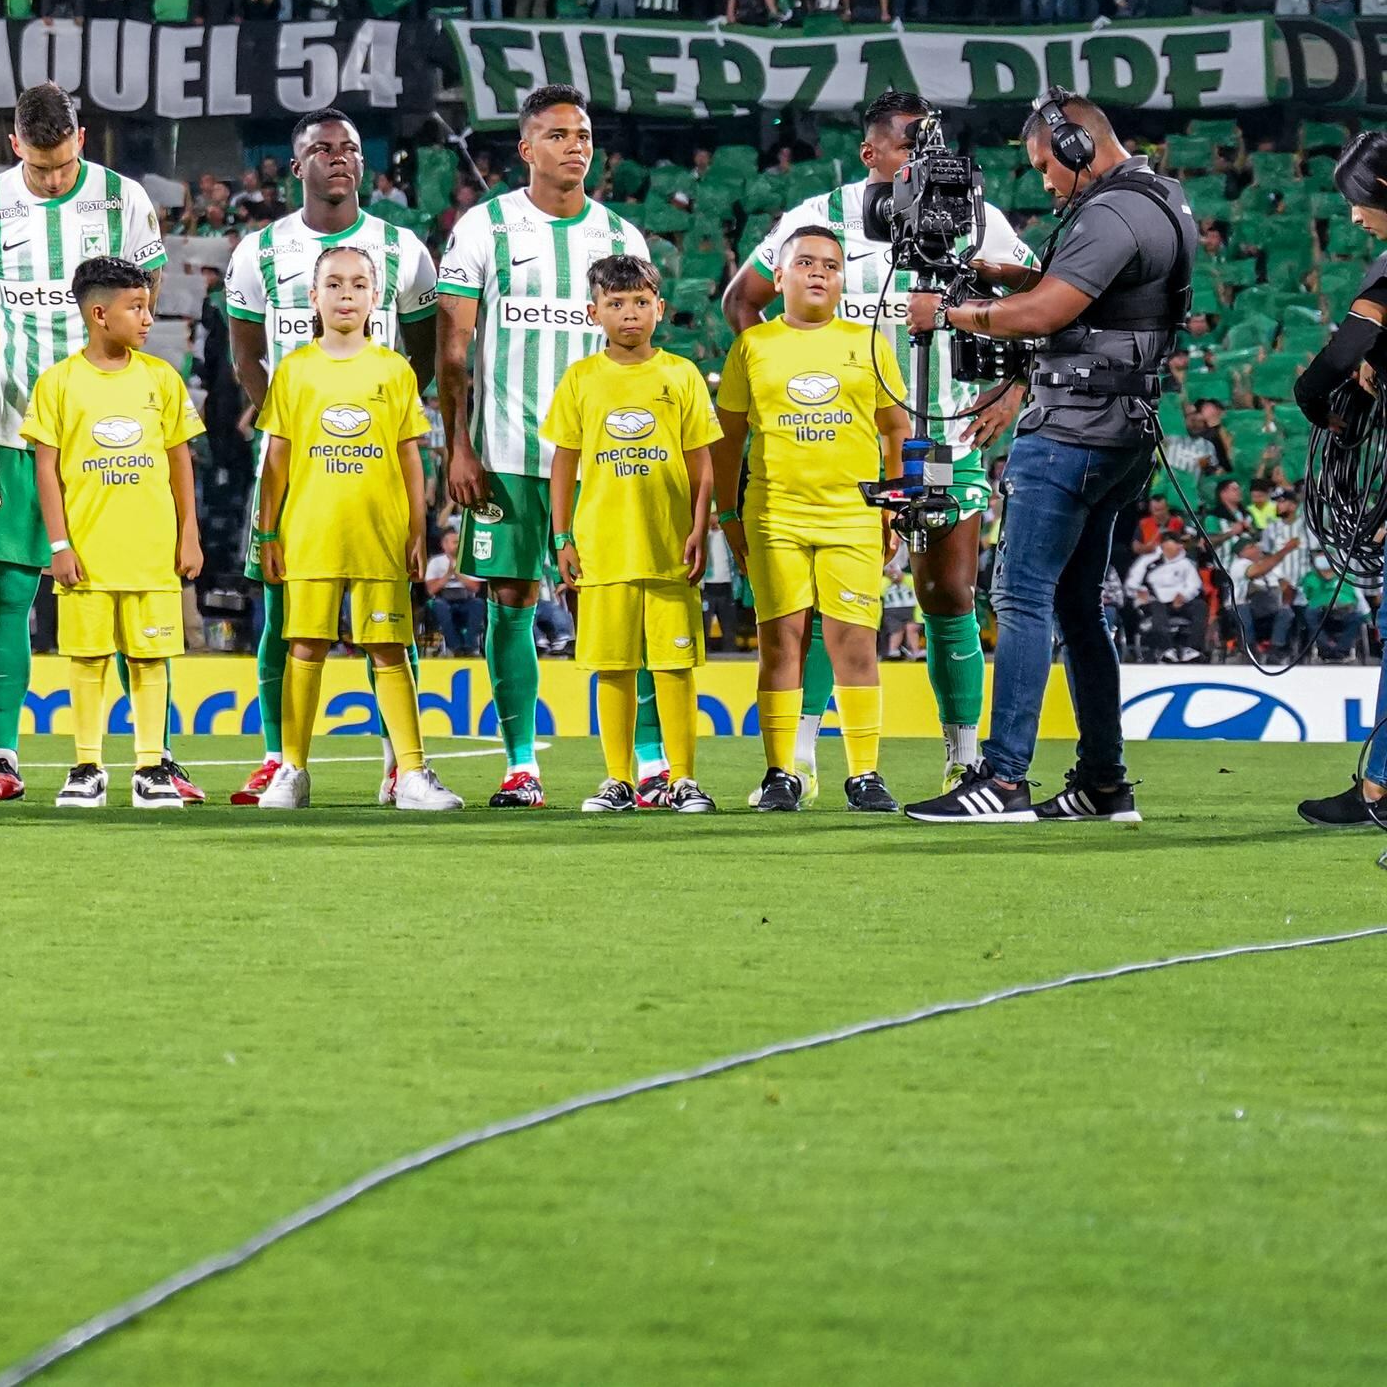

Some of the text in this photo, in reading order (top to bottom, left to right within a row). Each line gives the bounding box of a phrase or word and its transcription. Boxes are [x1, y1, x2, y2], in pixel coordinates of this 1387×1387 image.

[275, 19, 403, 113] 54
[3, 285, 77, 307] betss
[777, 409, 854, 427] mercado
[795, 426, 837, 442] libre
[309, 443, 384, 459] mercado
[595, 445, 669, 463] mercado
[82, 452, 155, 473] mercado
[325, 458, 364, 475] libre
[614, 461, 650, 478] libre
[101, 470, 141, 486] libre
